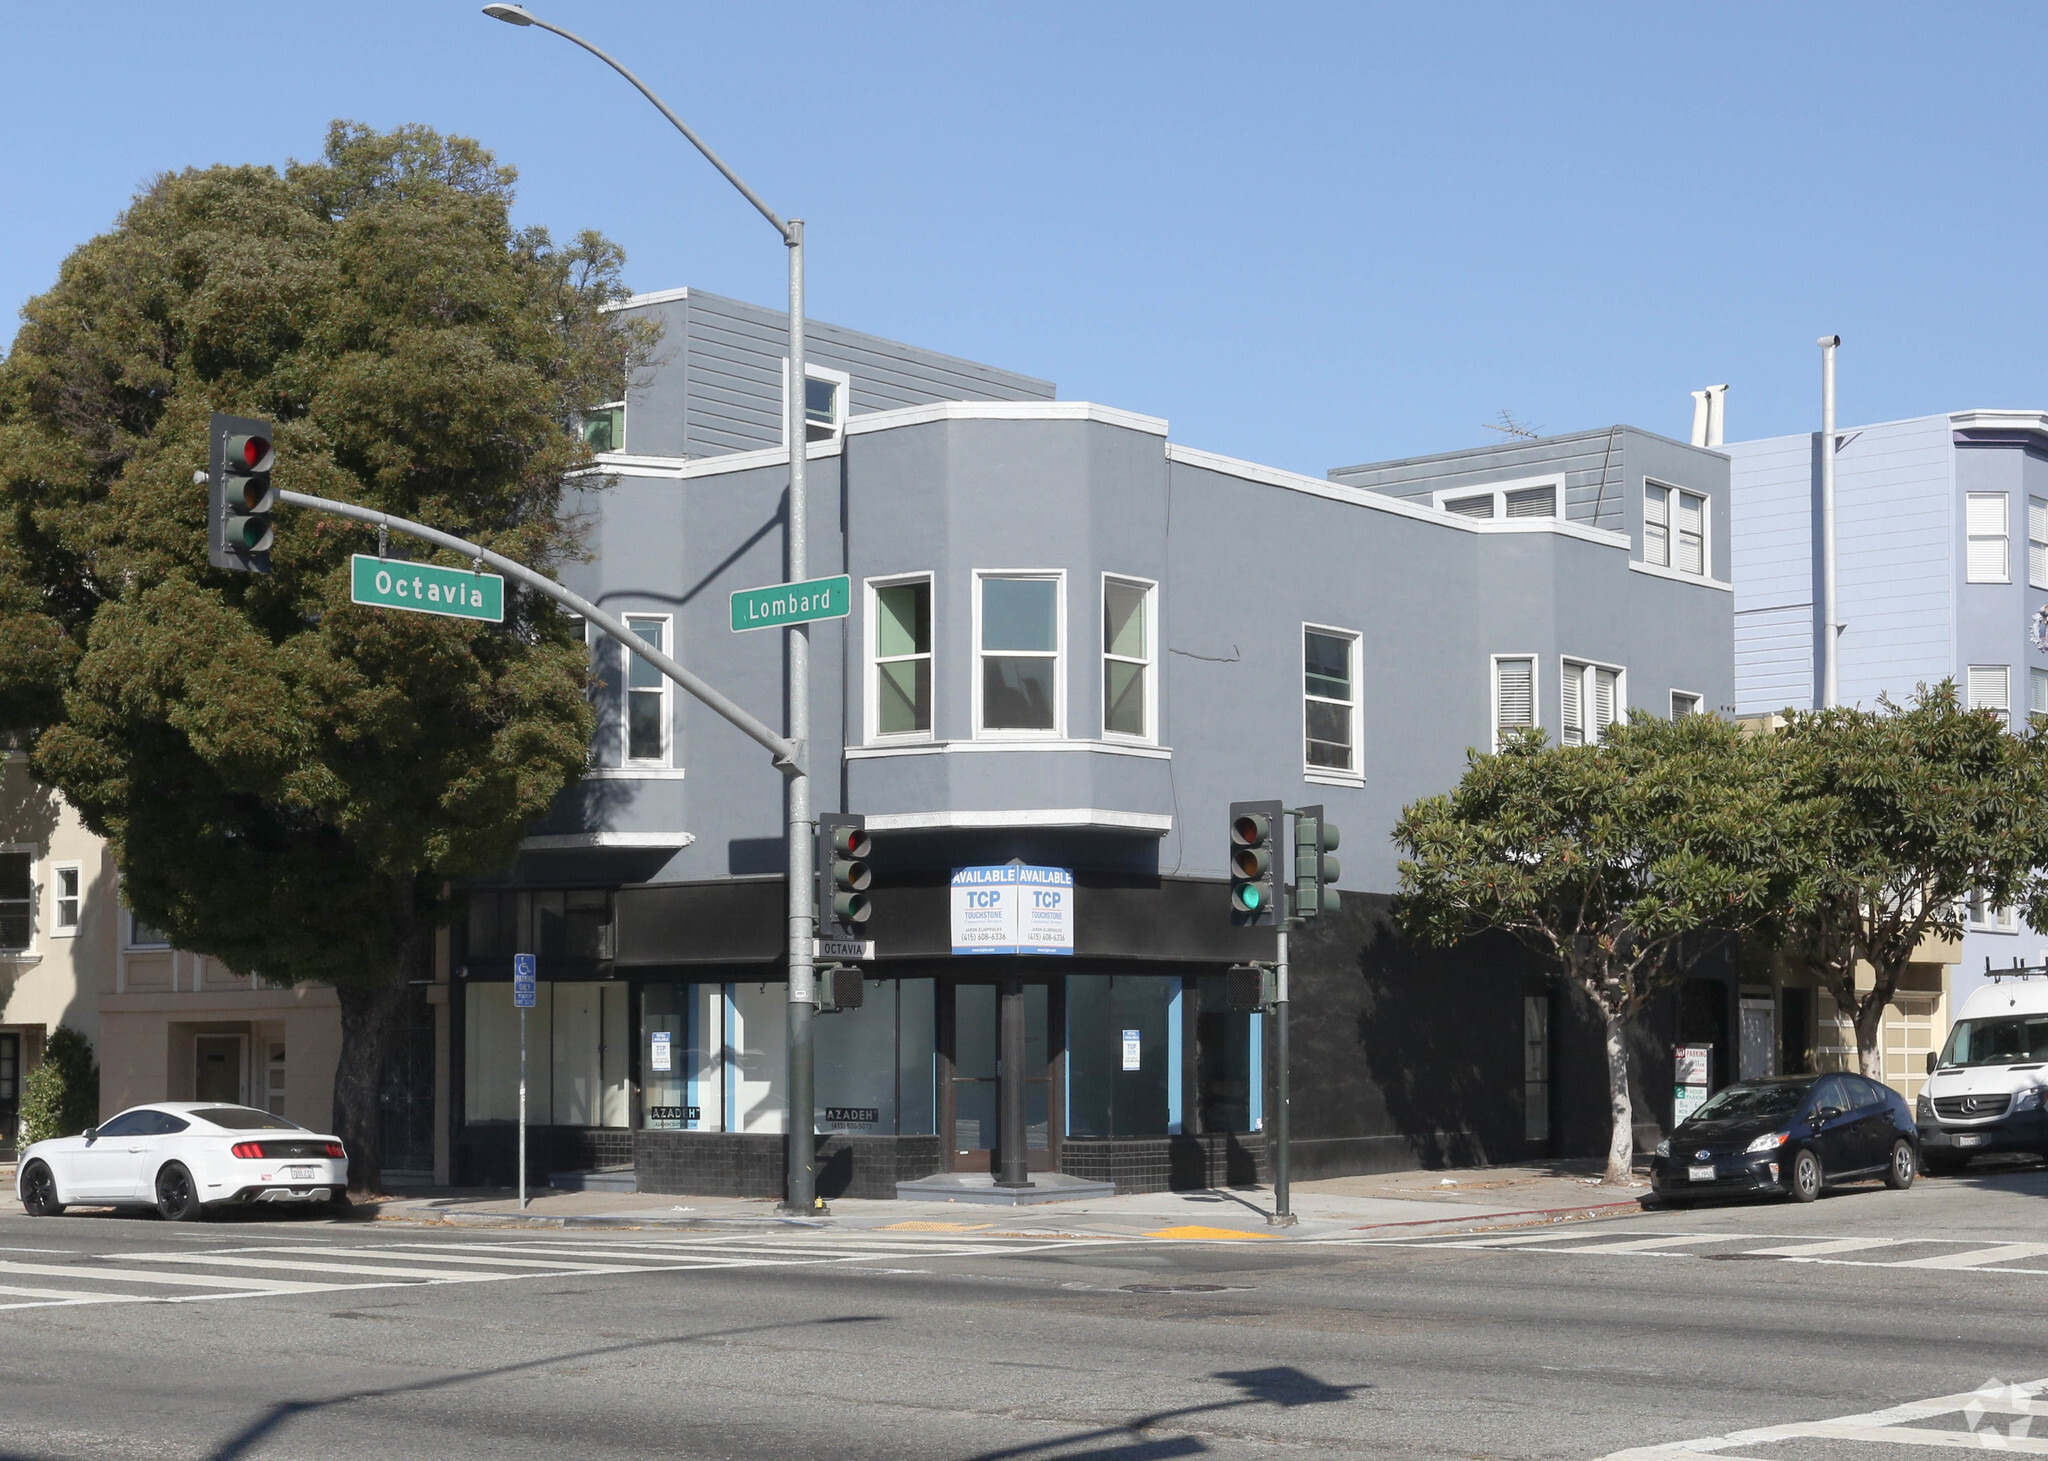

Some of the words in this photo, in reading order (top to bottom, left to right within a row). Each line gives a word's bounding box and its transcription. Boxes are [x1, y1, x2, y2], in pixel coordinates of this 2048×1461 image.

[375, 570, 483, 607] Octavia
[749, 588, 830, 620] Lombard
[952, 869, 1016, 884] AVAILABLE
[1019, 869, 1072, 884] AVAILABLE
[966, 890, 1001, 908] TCP
[1032, 891, 1062, 908] TCP
[965, 911, 1002, 920] TOUCHSTONE
[1031, 911, 1063, 920] TOUCHSTONE
[961, 932, 976, 942] (415)
[977, 932, 1007, 941] 608-6336
[1027, 932, 1041, 941] (415)
[1042, 933, 1066, 942] 608-6336
[824, 943, 863, 955] OCTAVIA
[1675, 1047, 1685, 1057] NO
[1686, 1049, 1708, 1058] PARKING
[1676, 1086, 1684, 1098] 2
